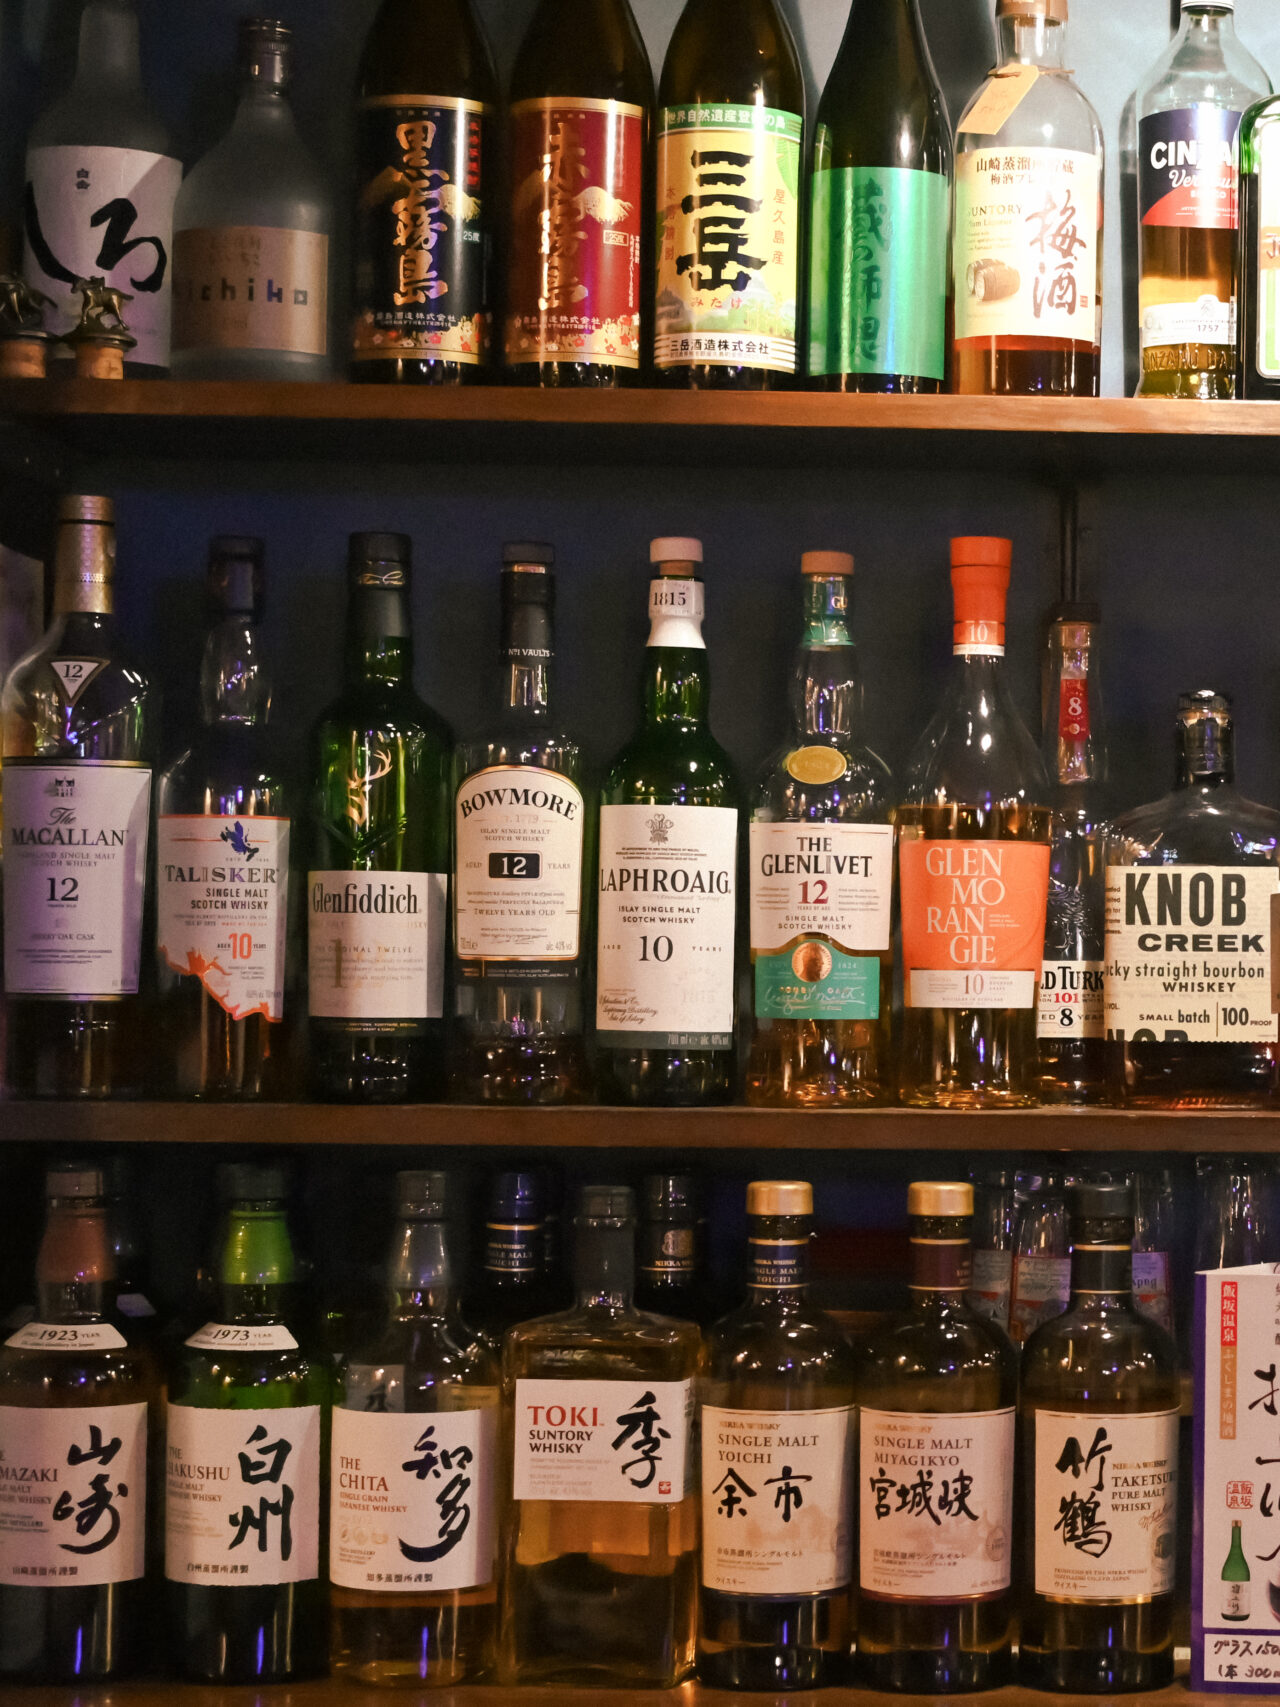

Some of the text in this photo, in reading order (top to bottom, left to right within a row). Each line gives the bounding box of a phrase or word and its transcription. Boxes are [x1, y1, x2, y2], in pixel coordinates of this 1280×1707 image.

[675, 150, 768, 292] 三岳
[1024, 188, 1088, 319] 梅酒
[690, 296, 744, 310] みたけ
[670, 338, 769, 355] 三岳酒造株式会社
[653, 592, 686, 606] 1815
[969, 623, 989, 642] 10
[522, 648, 550, 658] VAULTS
[63, 664, 83, 679] 12
[1068, 697, 1083, 716] 8
[461, 788, 578, 821] BOWMORE
[48, 806, 77, 826] The
[12, 827, 126, 847] MACALLAN
[796, 836, 832, 852] THE
[501, 856, 527, 875] 12
[761, 854, 872, 877] GLENLIVET
[925, 847, 1004, 877] GLEN
[164, 864, 277, 884] TALISKER
[600, 868, 730, 895] LAPHROAIG
[46, 877, 79, 902] 12
[206, 888, 269, 898] SINGLE MALT
[312, 882, 419, 914] Glenfiddich
[798, 879, 829, 905] 12
[951, 877, 1006, 906] MO
[1125, 872, 1247, 927] KNOB
[191, 900, 269, 910] SCOTCH WHISKY
[508, 908, 536, 916] YEARS
[678, 906, 701, 914] MALT
[622, 916, 695, 924] SCOTCH WHISKY
[926, 906, 986, 934] RAN
[229, 932, 252, 960] 10
[639, 935, 674, 962] 10
[949, 935, 996, 964] GIE
[1137, 933, 1265, 953] CREEK
[1135, 960, 1265, 982] straight bourbon
[964, 973, 984, 995] 10
[1163, 981, 1237, 993] WHISKEY
[1054, 992, 1079, 1004] 101
[1059, 1008, 1074, 1027] 8
[1139, 1007, 1273, 1027] SMALL batch 100 PROOF
[1222, 1284, 1236, 1342] 飯坂温泉
[39, 1329, 78, 1341] 1923
[213, 1329, 250, 1341] 1973
[527, 1405, 599, 1427] TOKI
[529, 1430, 593, 1442] SUNTORY
[718, 1433, 819, 1447] SINGLE MALT
[874, 1436, 973, 1450] SINGLE MALT
[529, 1442, 584, 1454] WHISKY
[718, 1450, 772, 1464] YOICHI
[340, 1456, 361, 1471] THE
[874, 1453, 960, 1467] MIYAGIKYO
[52, 1425, 129, 1555] 山崎
[339, 1472, 390, 1492] CHITA
[192, 1494, 222, 1502] WHISKY
[228, 1425, 295, 1561] 白州
[398, 1425, 473, 1563] 知多
[712, 1465, 813, 1523] 余市
[1054, 1427, 1113, 1559] 竹鶴
[1111, 1488, 1166, 1500] PURE MALT
[1111, 1501, 1152, 1512] WHISKY
